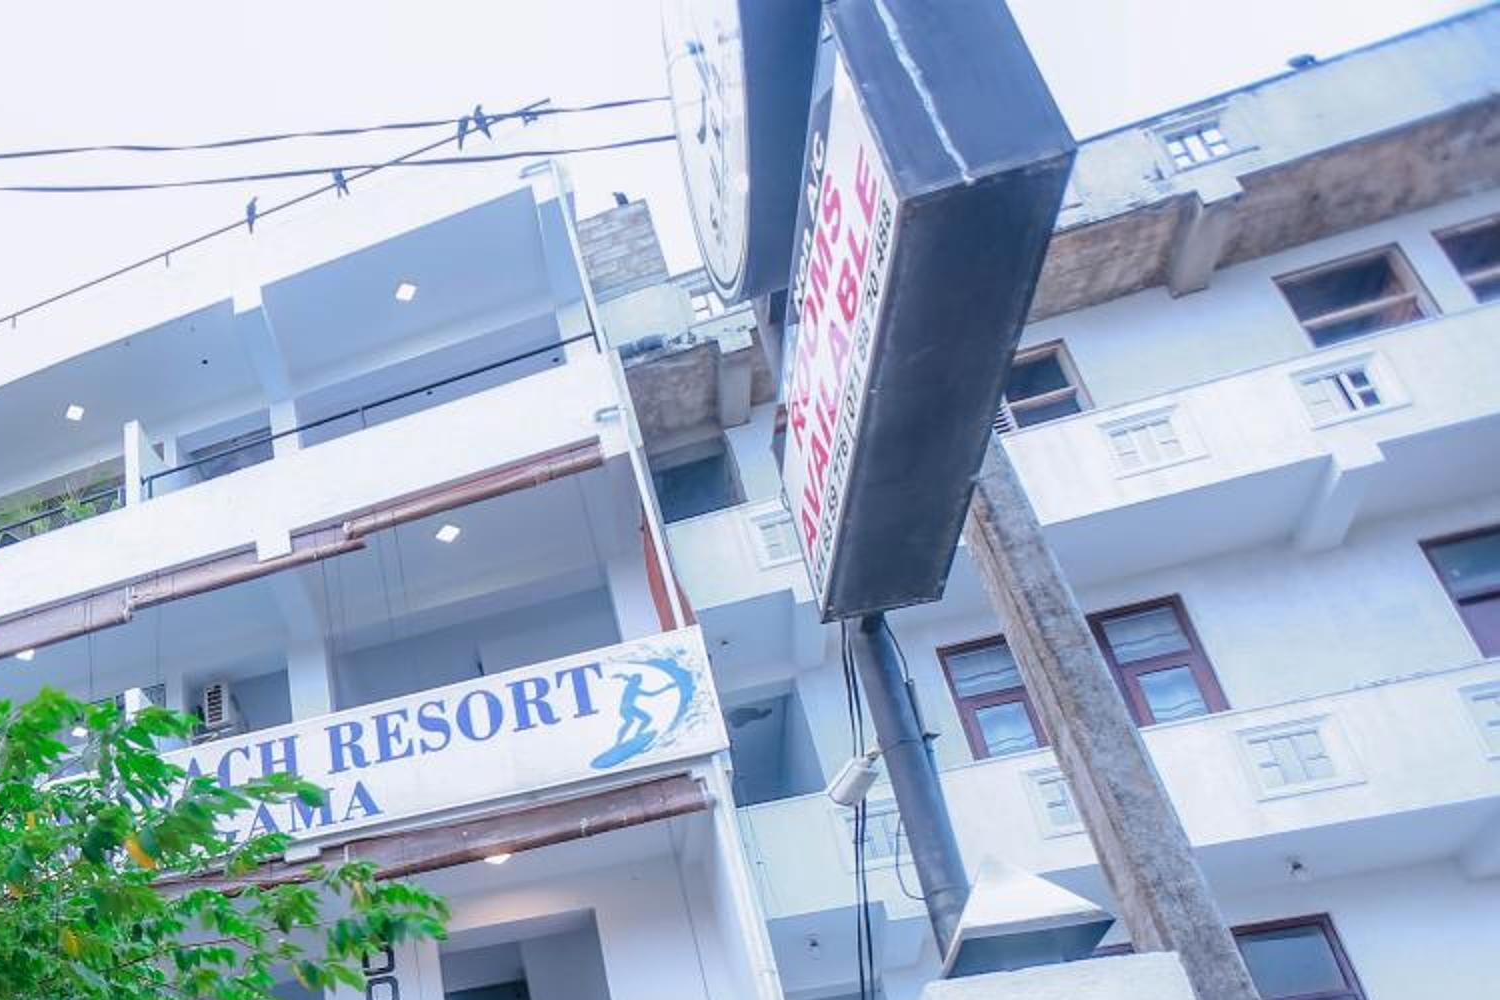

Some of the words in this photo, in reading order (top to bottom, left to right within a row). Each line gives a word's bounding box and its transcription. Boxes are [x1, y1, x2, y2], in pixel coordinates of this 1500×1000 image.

[790, 172, 842, 452] ROOMS
[801, 143, 878, 561] AVAILABLE
[324, 661, 603, 775] RESORT
